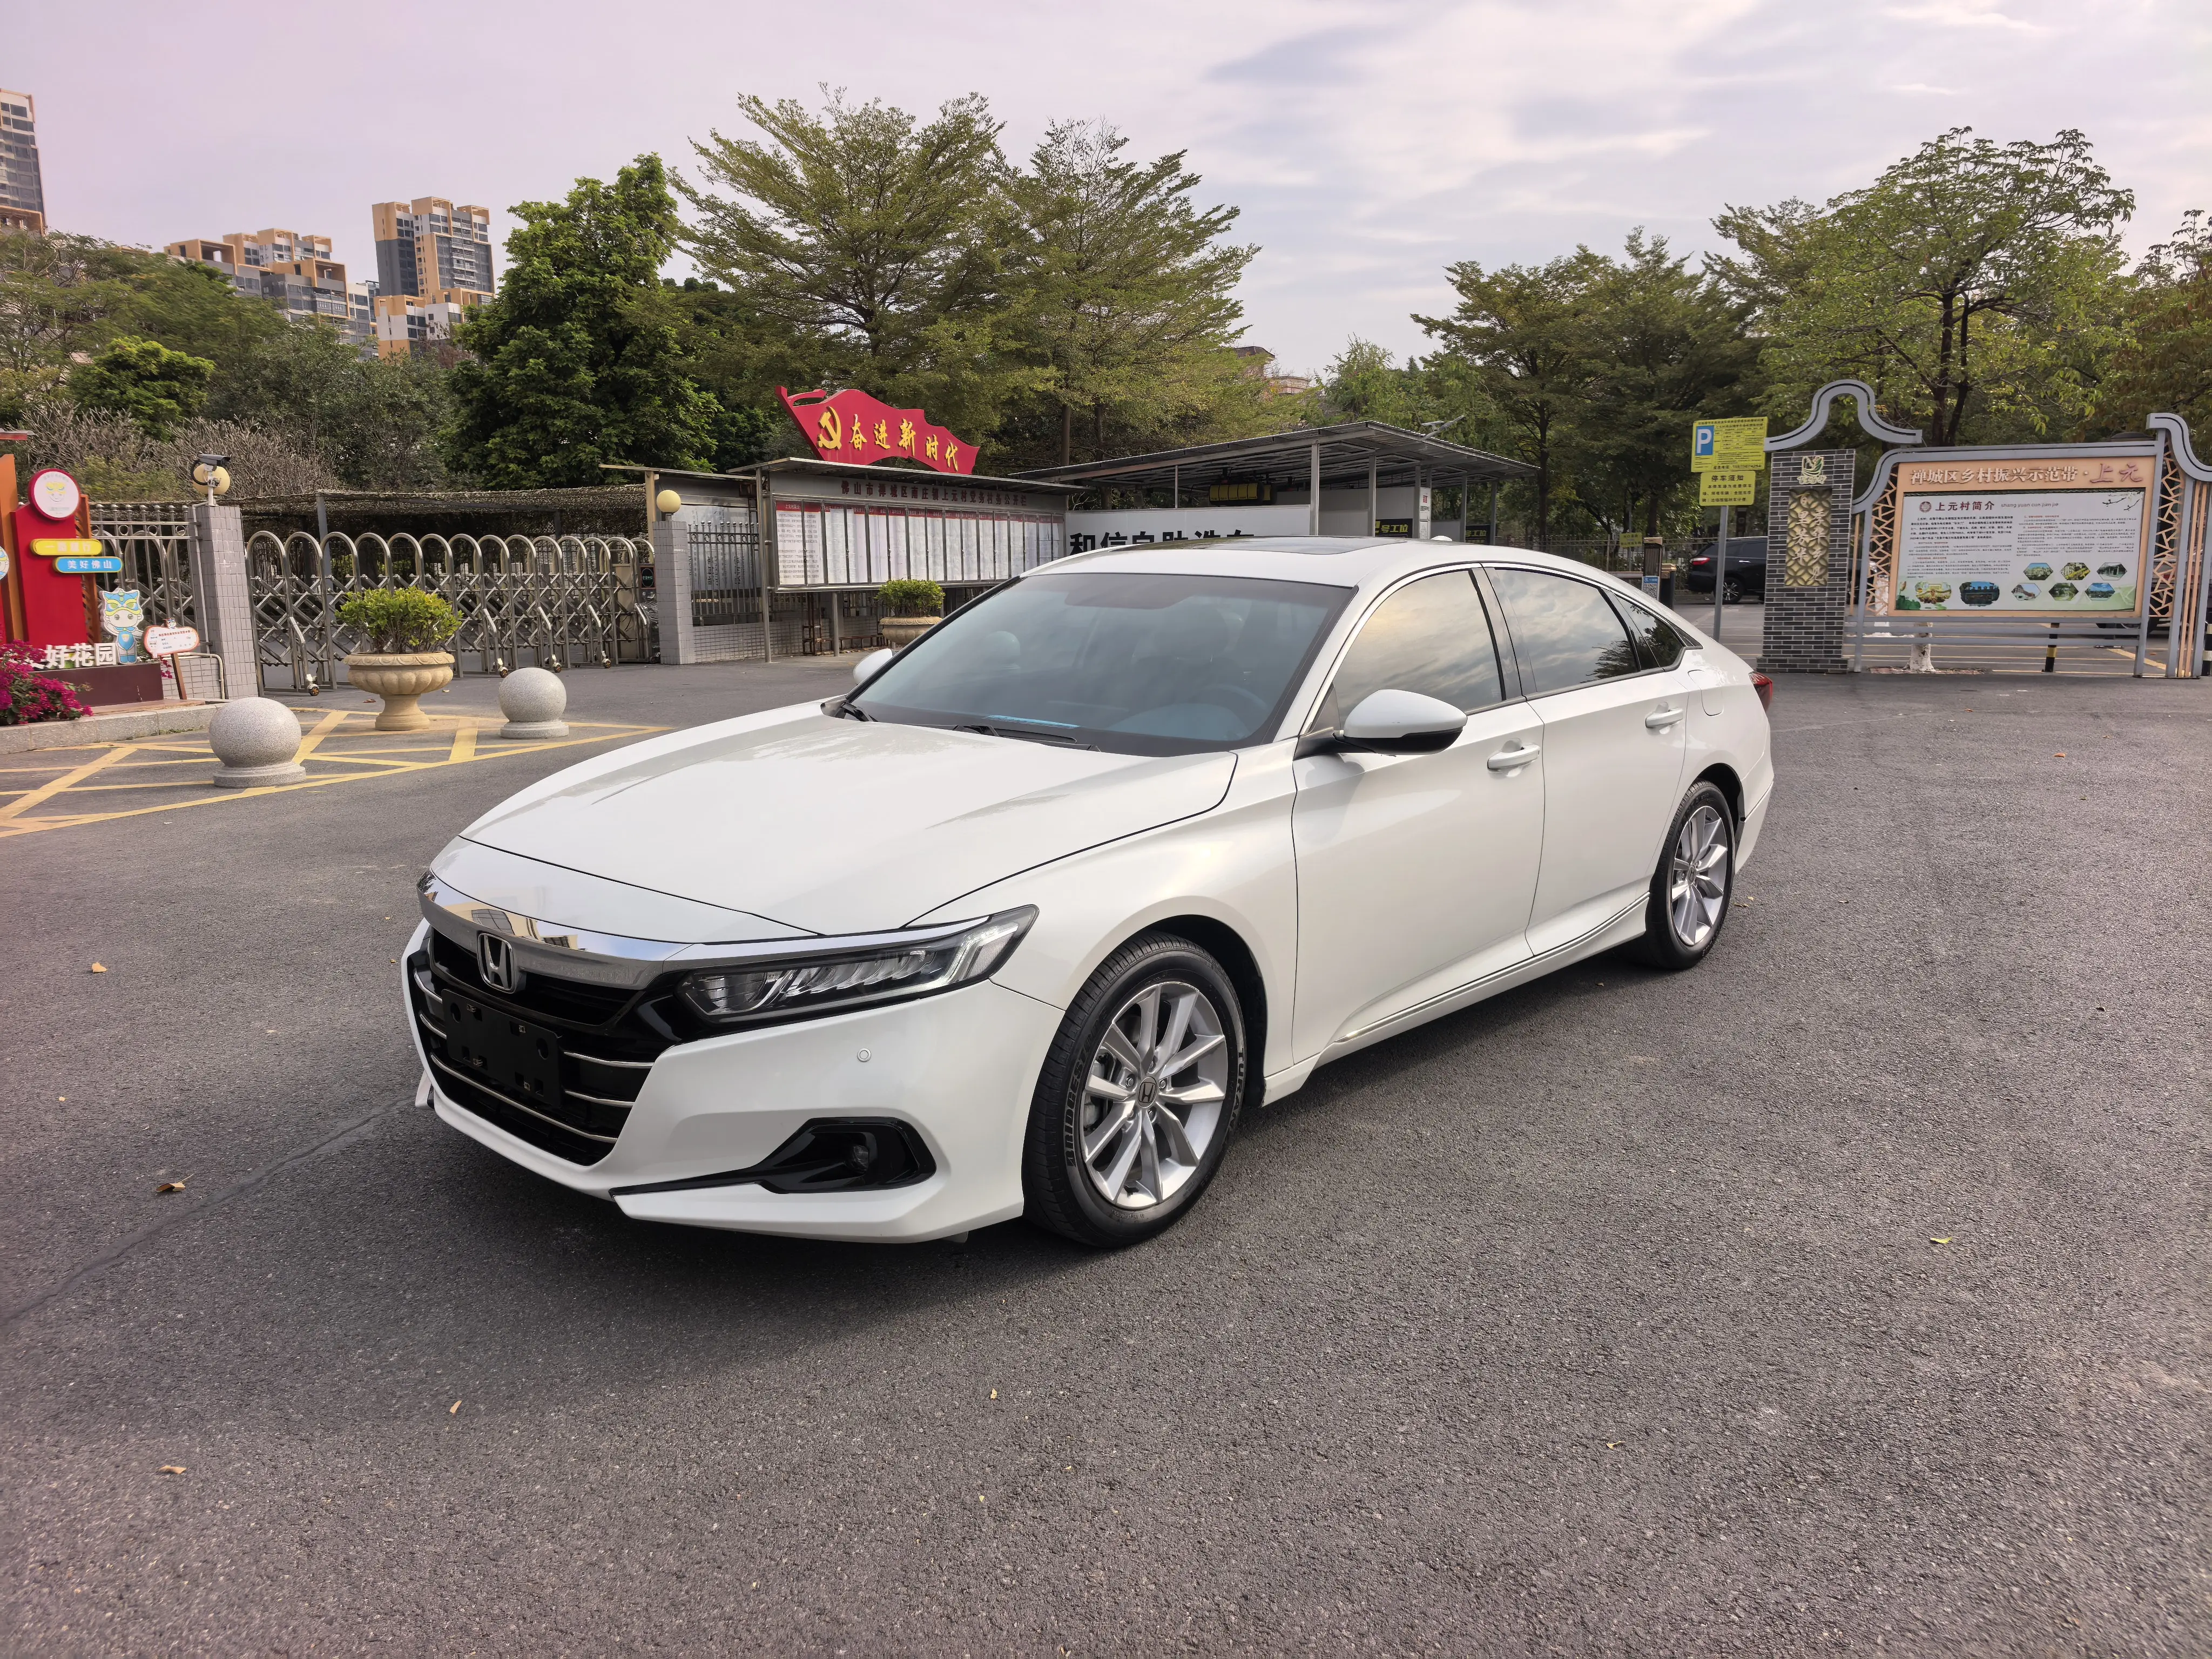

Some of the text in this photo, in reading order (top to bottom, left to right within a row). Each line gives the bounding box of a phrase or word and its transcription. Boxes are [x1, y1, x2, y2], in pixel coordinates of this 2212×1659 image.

[849, 414, 958, 471] 奋进新时代
[1696, 429, 1711, 454] P
[1936, 501, 1995, 510] 上元村简介
[67, 560, 113, 569] 美好佛山
